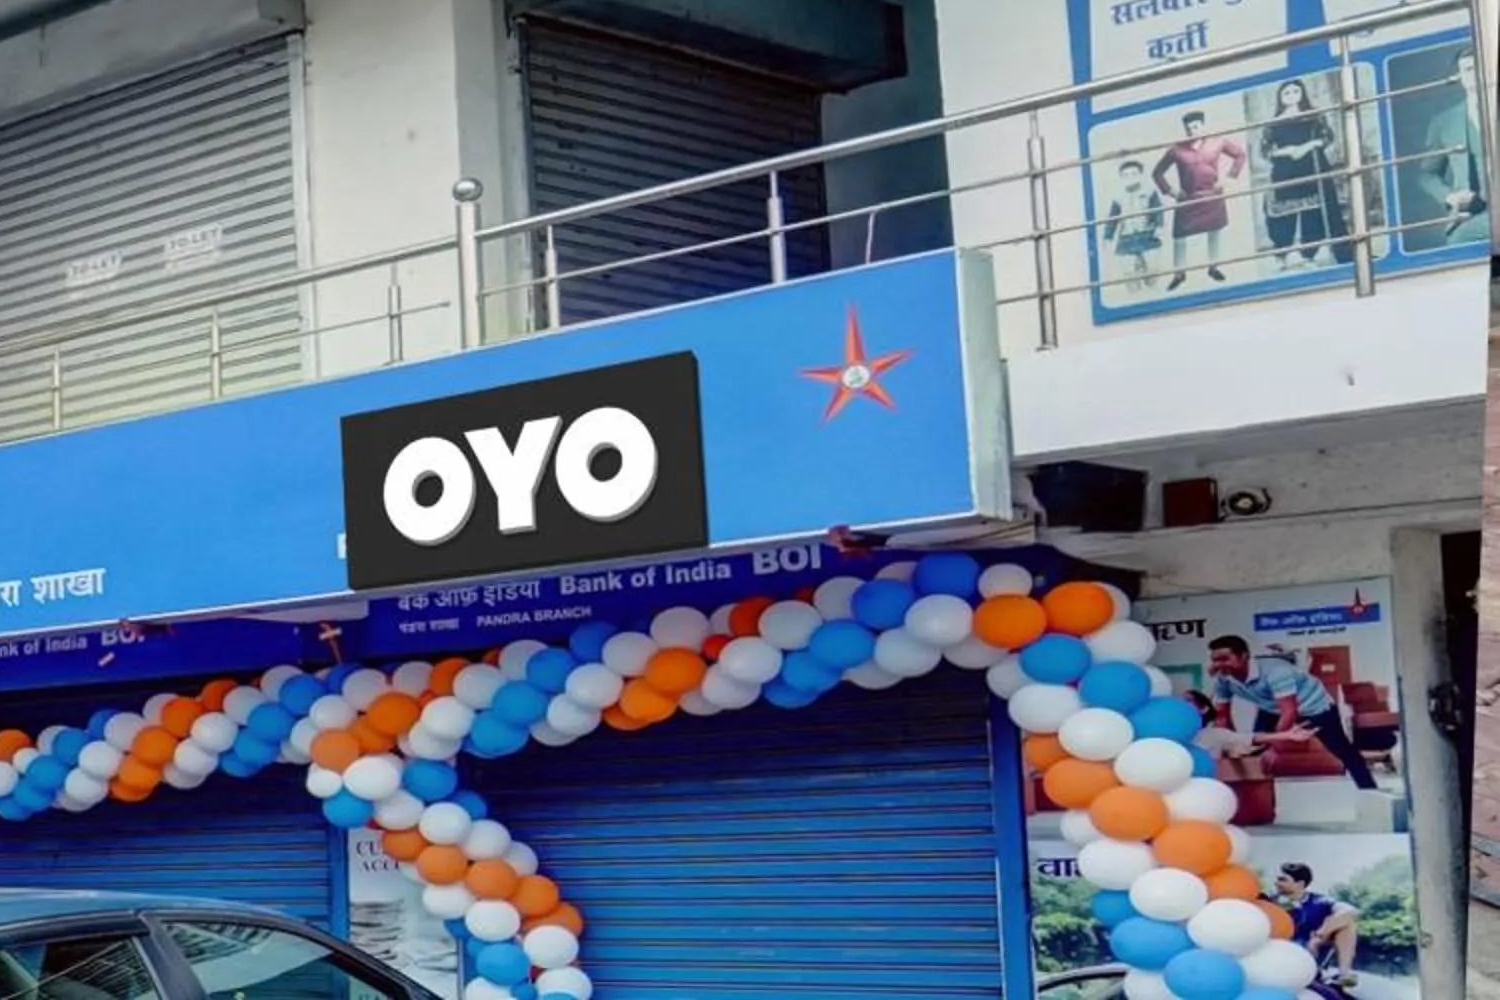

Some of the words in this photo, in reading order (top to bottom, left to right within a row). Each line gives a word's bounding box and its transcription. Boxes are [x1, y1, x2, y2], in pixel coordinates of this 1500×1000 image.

[383, 406, 659, 546] OYO
[30, 567, 106, 605] शाखा
[559, 566, 624, 596] Bank
[630, 560, 656, 586] of
[665, 557, 732, 583] India
[752, 543, 821, 576] BOI
[475, 609, 531, 628] PANDRA
[533, 605, 592, 622] BRANCH
[23, 639, 40, 655] of
[45, 633, 88, 654] India
